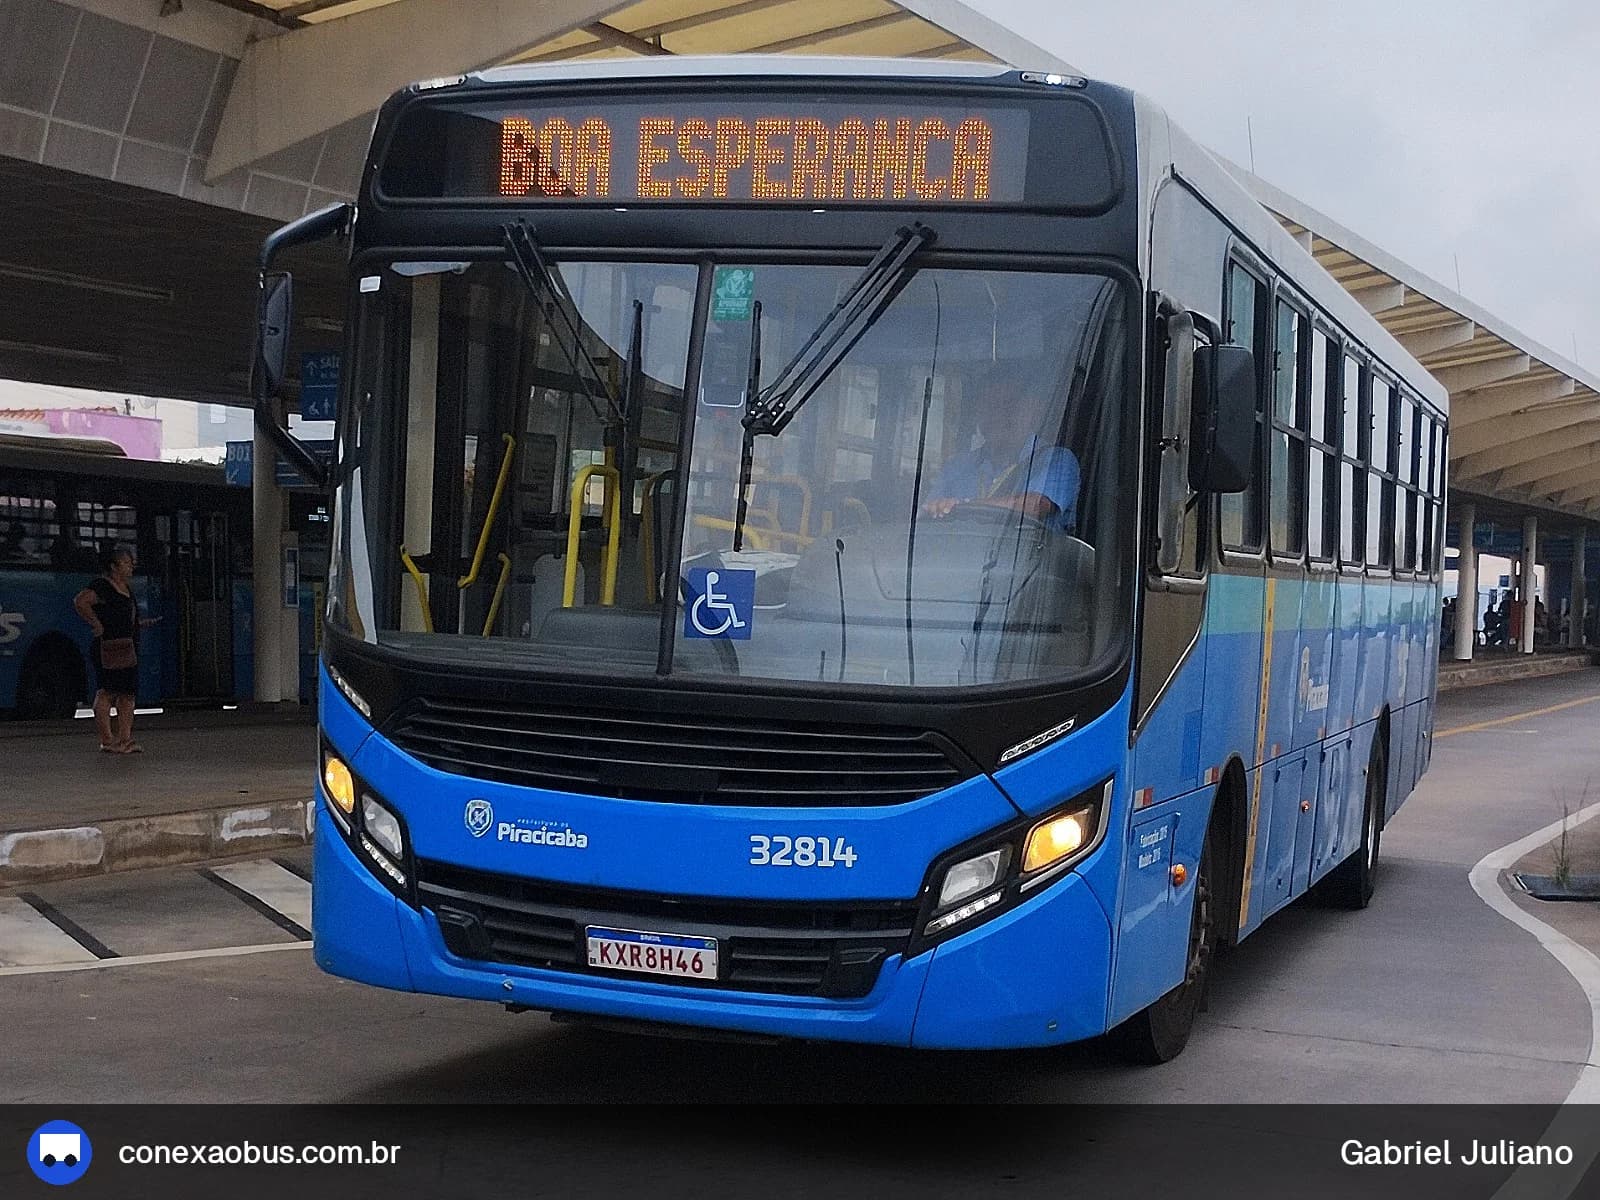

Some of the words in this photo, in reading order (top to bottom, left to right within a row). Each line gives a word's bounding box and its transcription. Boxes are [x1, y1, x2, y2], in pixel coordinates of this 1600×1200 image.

[501, 118, 611, 197] BOA
[637, 118, 992, 200] ESPERANCA
[498, 822, 588, 848] Piracicaba
[750, 835, 857, 868] 32814
[600, 942, 703, 974] KXR8H46
